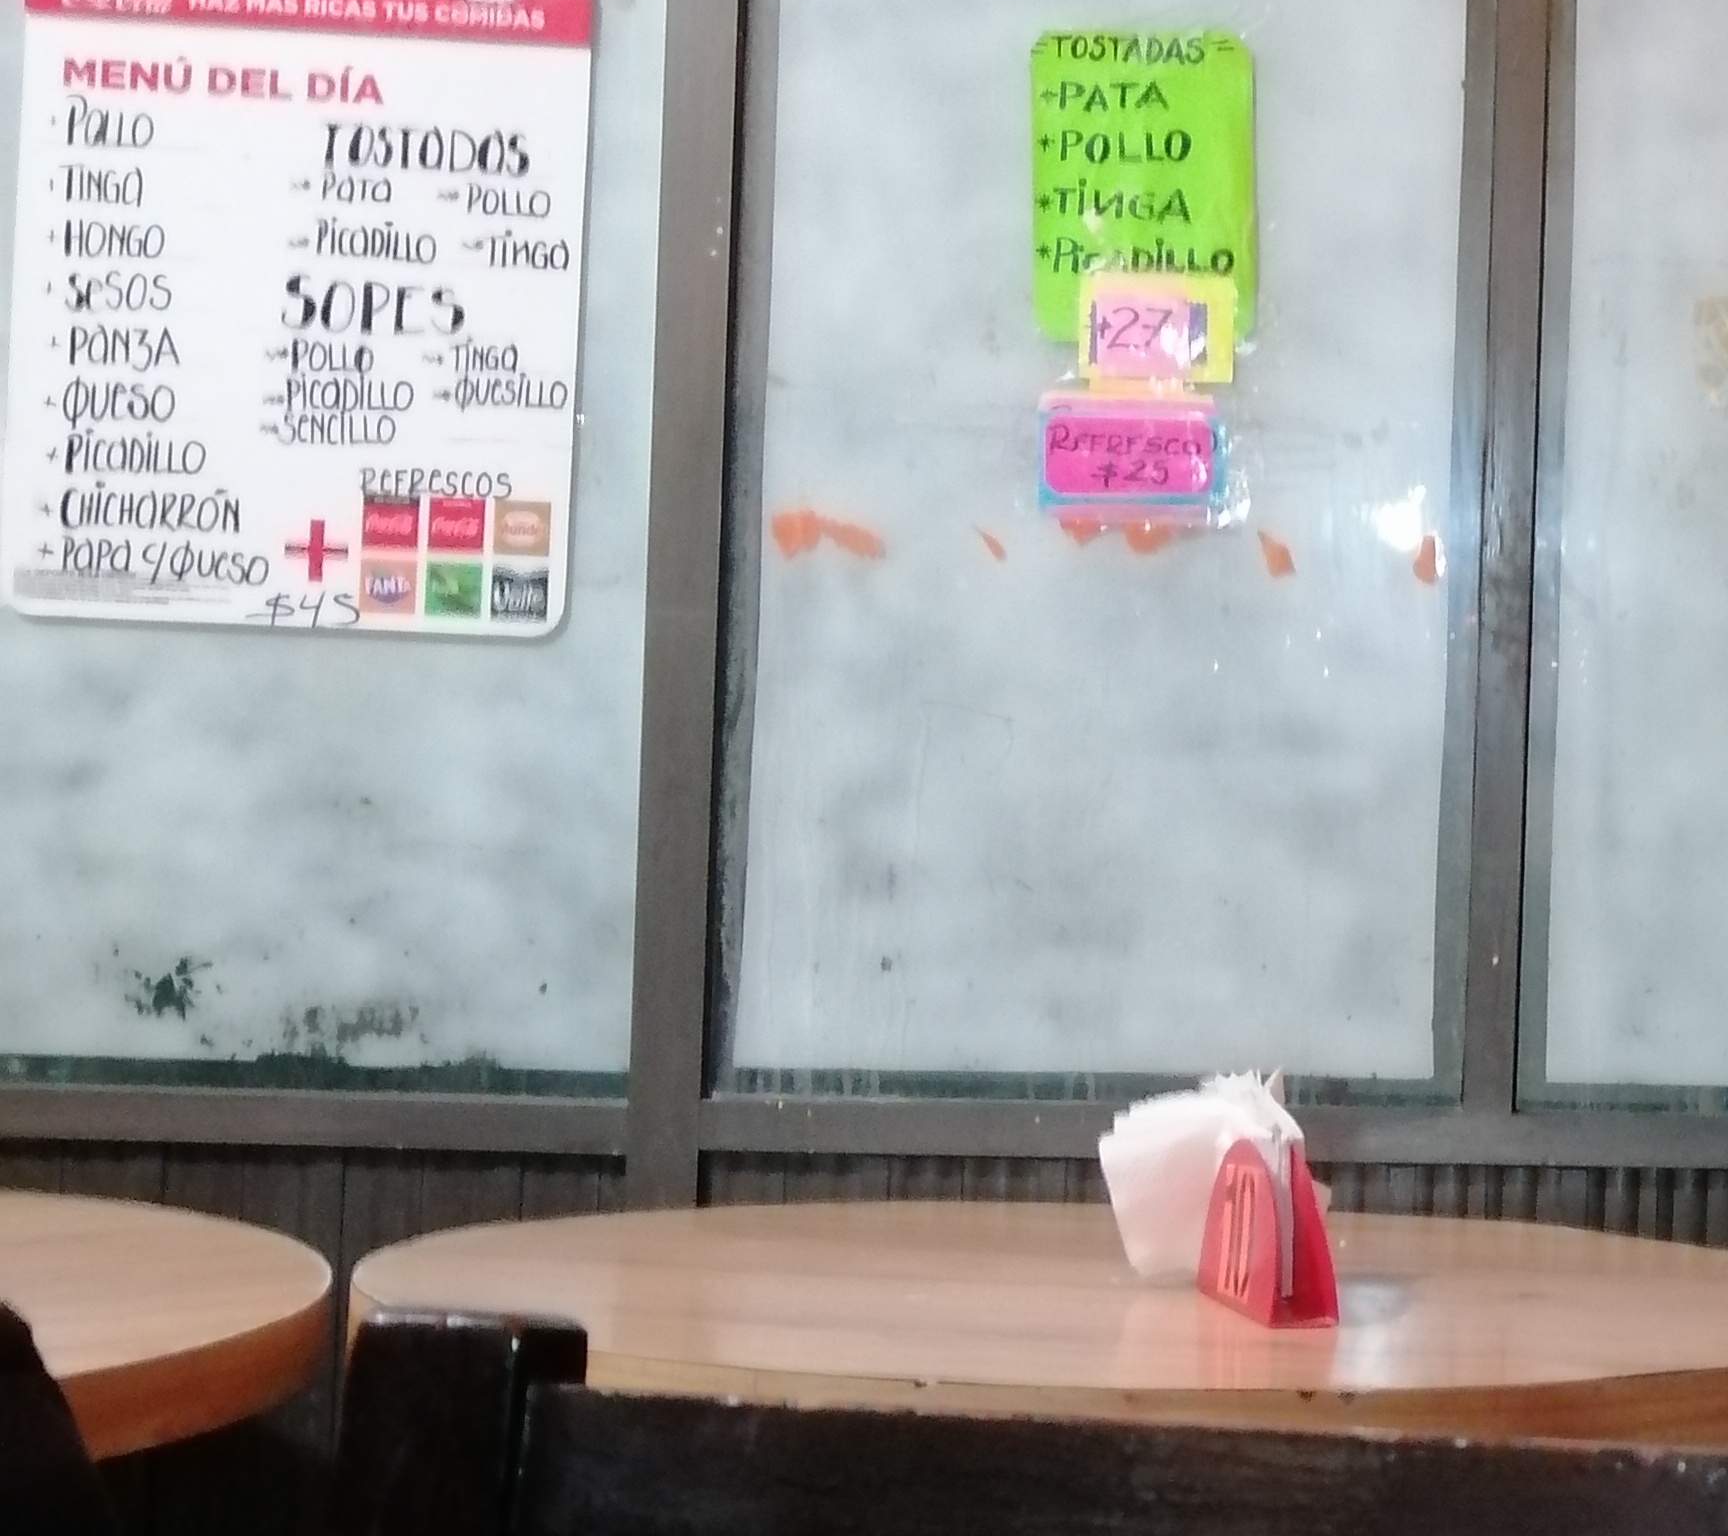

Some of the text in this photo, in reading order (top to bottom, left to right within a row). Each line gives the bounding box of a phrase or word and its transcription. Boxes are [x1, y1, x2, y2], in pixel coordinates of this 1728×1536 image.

[382, 0, 429, 23] TUS
[433, 4, 546, 31] COMIDAS
[1051, 34, 1206, 66] TOSTADAS
[63, 55, 384, 105] MENÚ DEL DÍA
[1058, 80, 1170, 113] PATA
[1060, 129, 1193, 164] POLLO
[466, 183, 551, 218] POLLO
[64, 218, 165, 259] HONGO
[281, 273, 465, 335] SOPES
[291, 338, 374, 374] POLLO
[263, 590, 361, 628] $45
